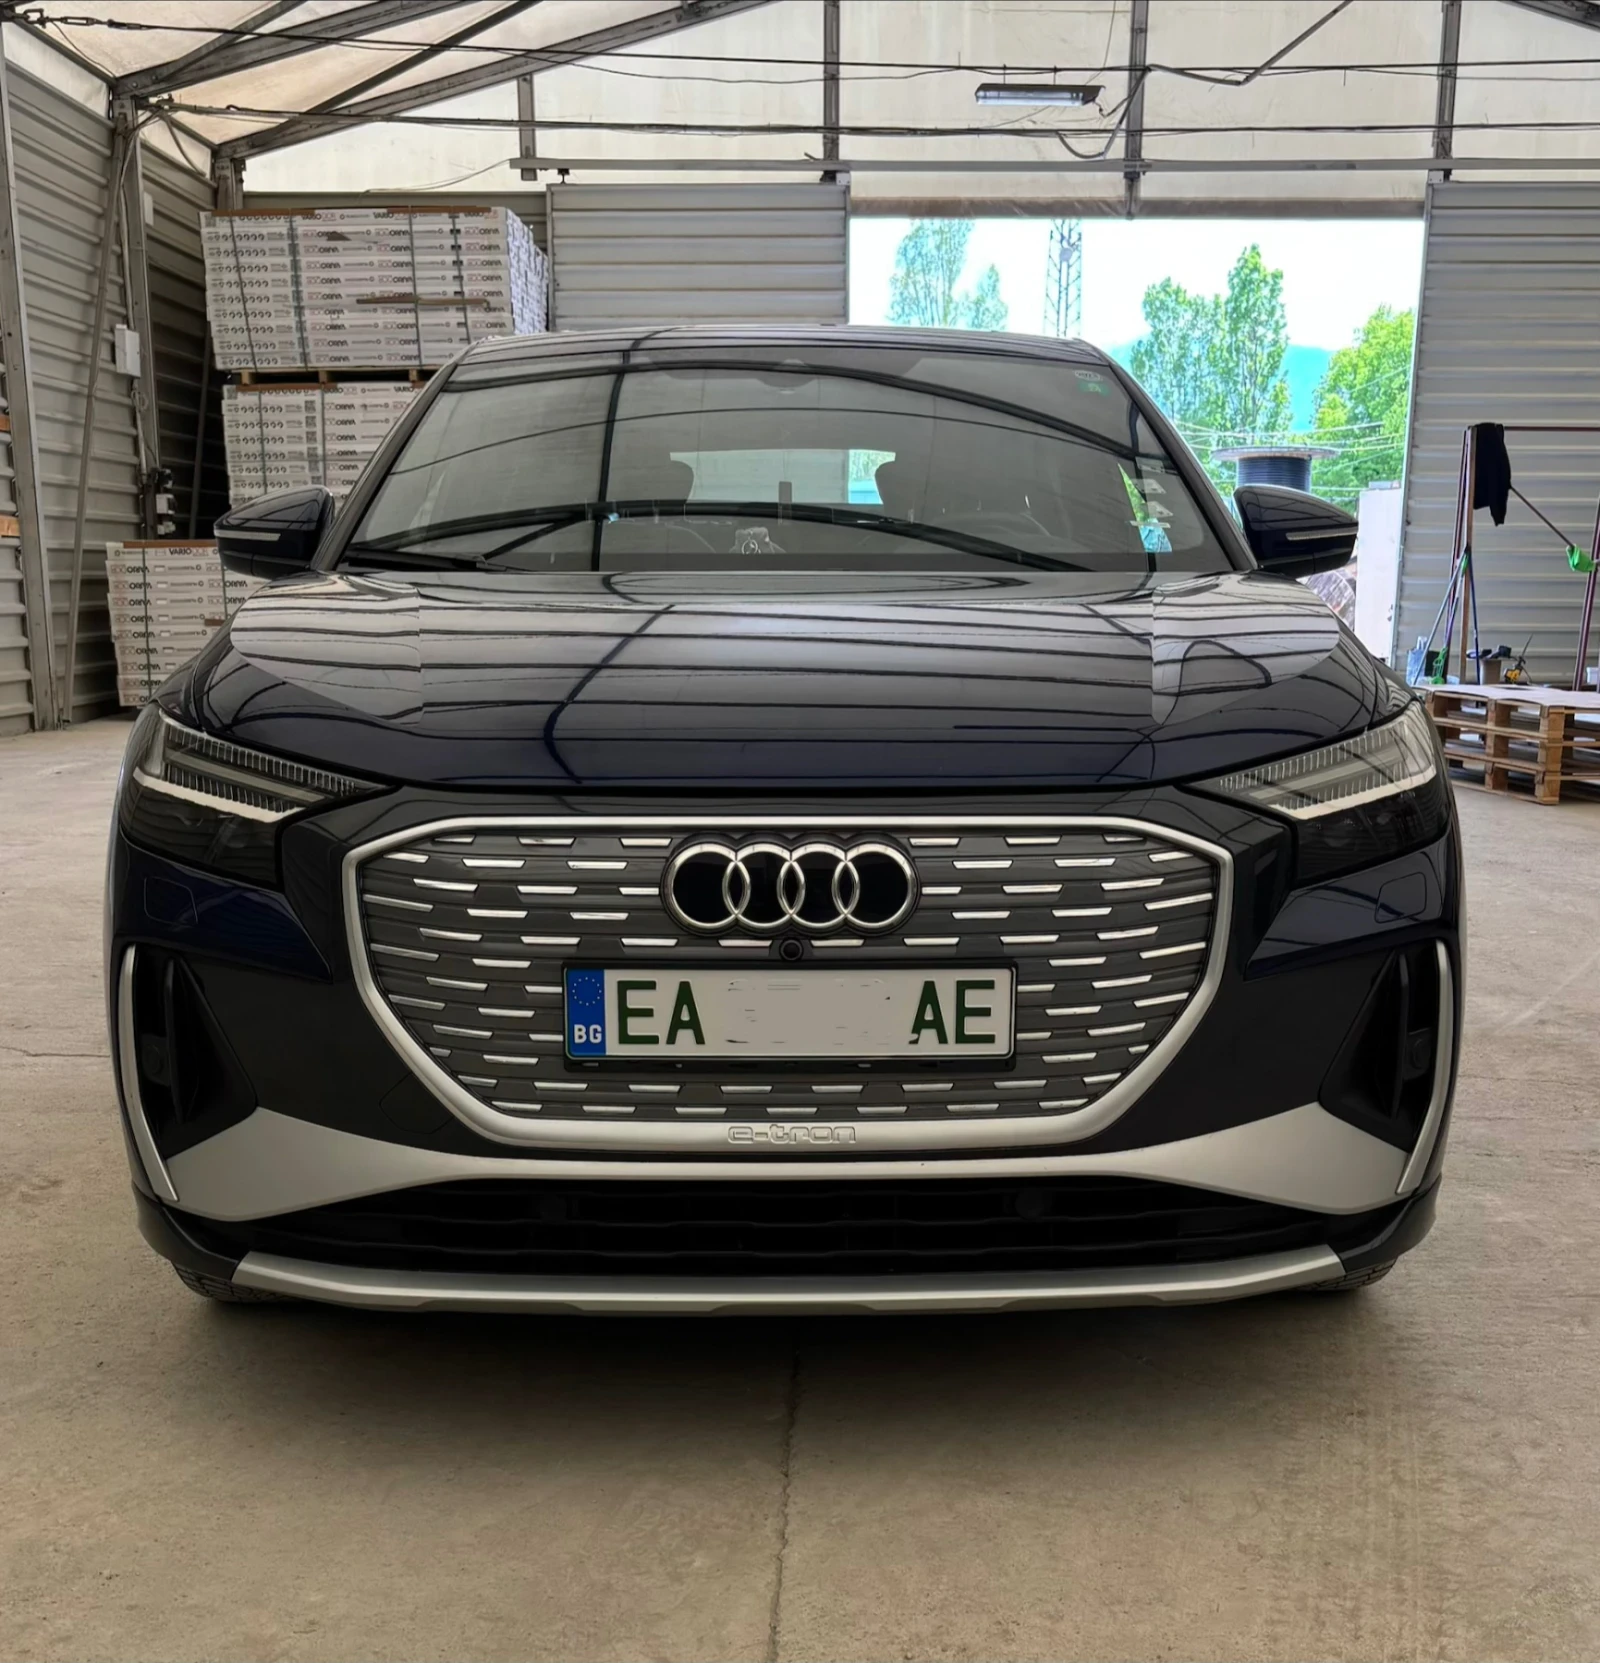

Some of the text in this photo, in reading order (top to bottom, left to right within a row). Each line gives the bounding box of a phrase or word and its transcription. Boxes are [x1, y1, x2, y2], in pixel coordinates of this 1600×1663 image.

[617, 979, 996, 1045] EA AE
[574, 1024, 602, 1044] BG
[728, 1124, 856, 1144] e-tron
